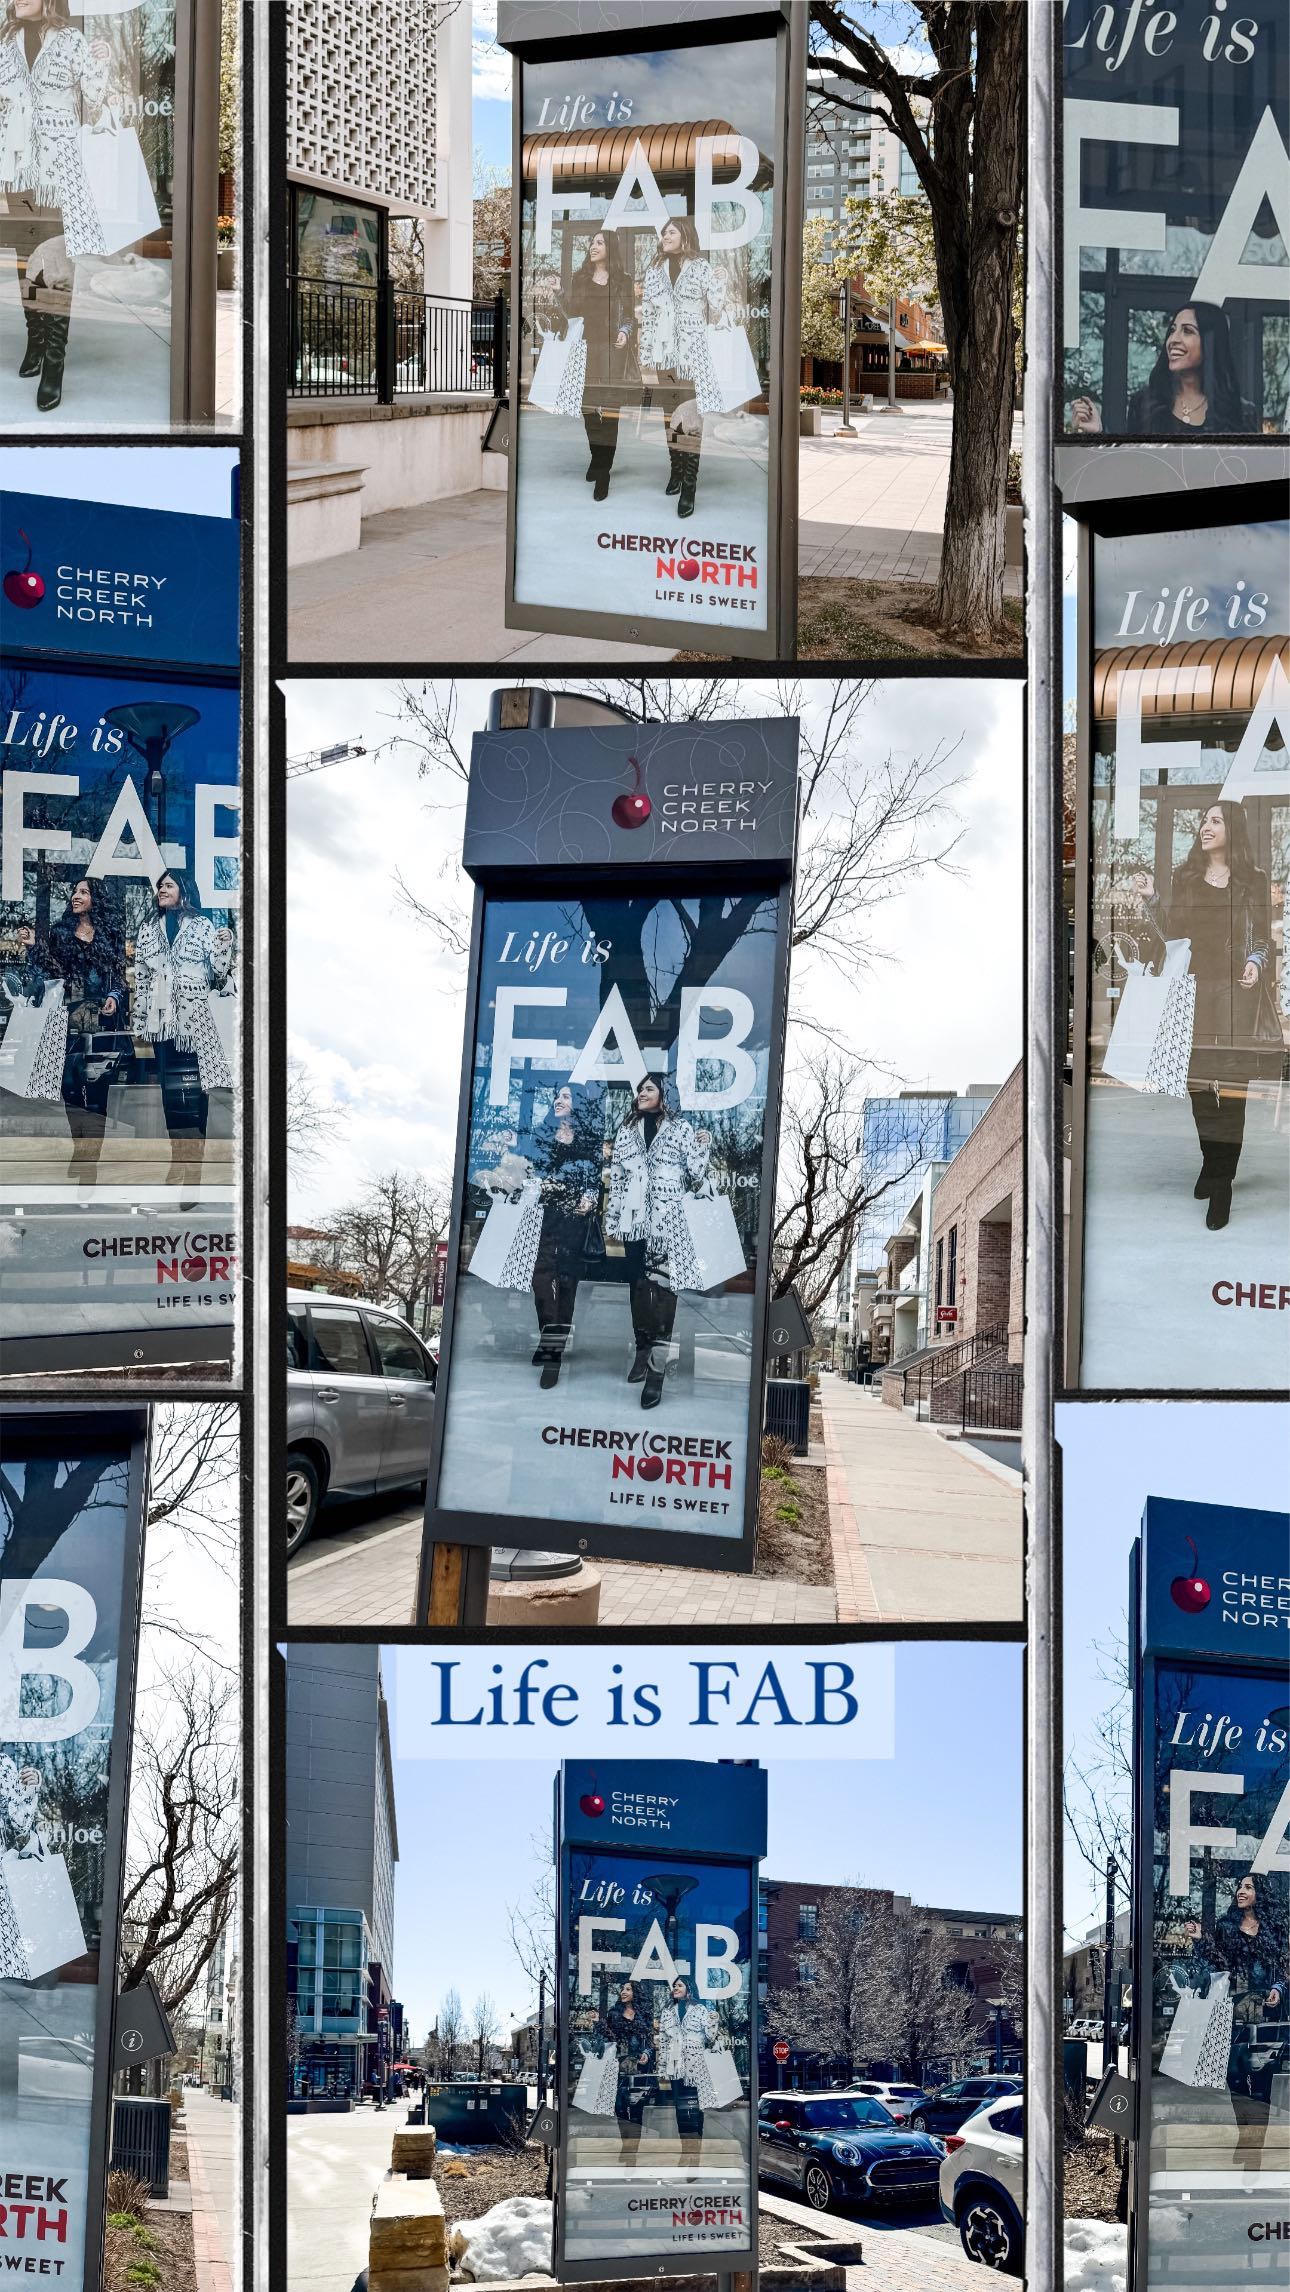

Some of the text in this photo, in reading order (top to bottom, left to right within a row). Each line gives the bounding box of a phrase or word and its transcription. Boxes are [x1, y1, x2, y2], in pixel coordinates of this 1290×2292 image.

[1063, 0, 1258, 71] Life is
[536, 91, 633, 132] Life is
[536, 135, 764, 254] FAB
[597, 533, 757, 563] CHERRY CREEK
[57, 565, 167, 591] CHERRY
[656, 557, 758, 589] NORTH
[57, 585, 146, 608] CREEK
[655, 590, 757, 611] LIFE IS SWEET
[57, 605, 153, 627] NORTH
[1114, 580, 1269, 647] Life is
[1, 709, 124, 758] Life is
[663, 781, 774, 797] CHERRY
[662, 800, 751, 815] CREEK
[661, 818, 757, 833] NORTH
[496, 930, 612, 972] Life is
[488, 982, 758, 1111] FAB
[83, 1235, 182, 1258] CHERRY
[157, 1296, 191, 1309] LIFE
[198, 1295, 213, 1306] IS
[541, 1426, 732, 1460] CHERRY CREEK
[612, 1453, 732, 1490] NORTH
[610, 1492, 730, 1514] LIFE IS SWEET
[1168, 1711, 1287, 1758] Life is
[611, 1791, 679, 1806] CHERRY
[611, 1803, 667, 1818] CREEK
[611, 1815, 671, 1830] NORTH
[578, 1879, 653, 1908] Life is
[578, 1915, 743, 2000] FAB
[774, 2046, 789, 2054] STOP
[628, 2195, 742, 2211] CHERRY CREEK
[672, 2209, 743, 2227] NORTH
[672, 2231, 743, 2242] LIFE IS SWEET
[0, 2254, 65, 2275] WEET
